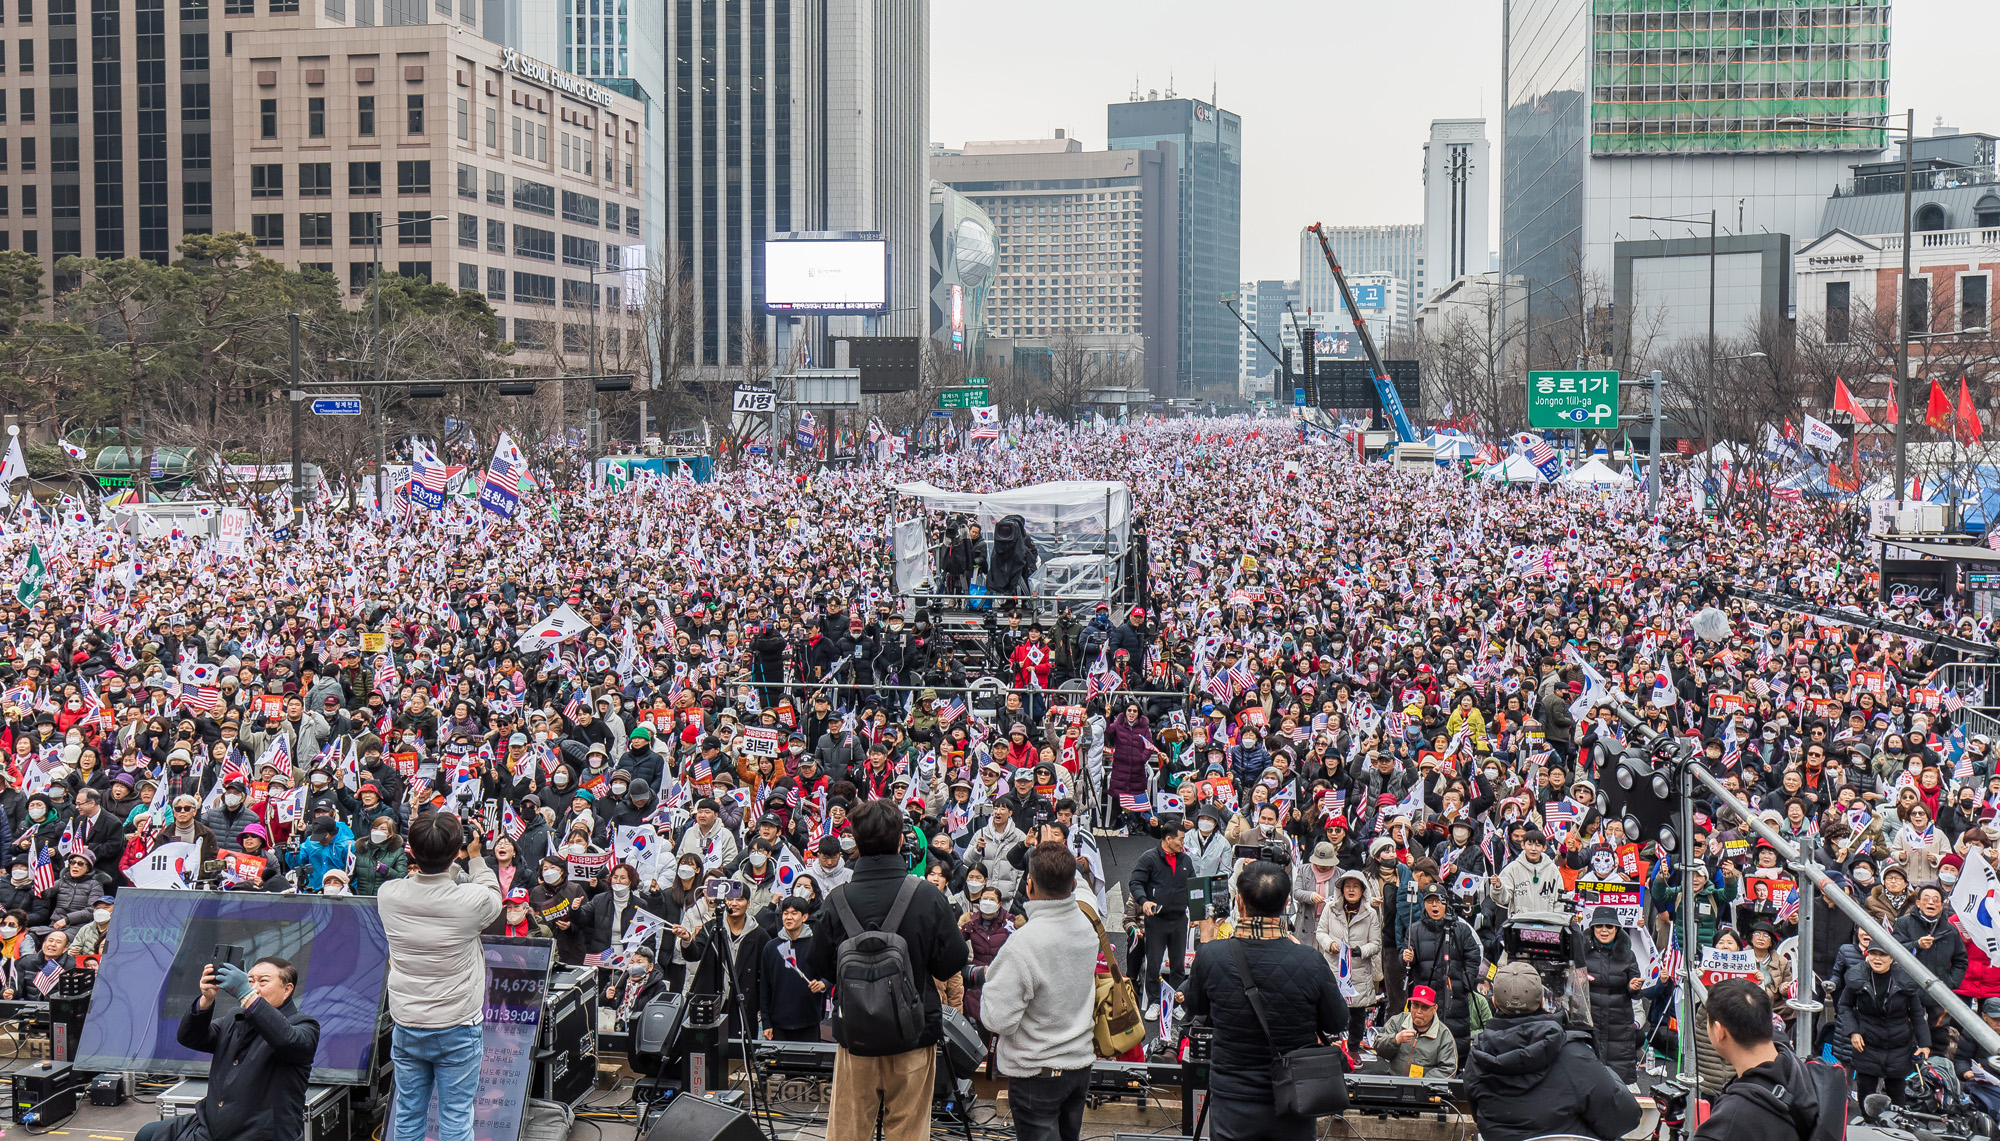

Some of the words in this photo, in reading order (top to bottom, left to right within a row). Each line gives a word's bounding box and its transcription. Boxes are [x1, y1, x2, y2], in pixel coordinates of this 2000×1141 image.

[521, 58, 549, 84] SEOUL
[550, 69, 586, 97] FINANCE
[586, 84, 614, 107] CENTER
[1809, 254, 1864, 265] 한국금융사박물관
[1535, 376, 1610, 394] 종로1가
[738, 393, 773, 410] 사형
[1535, 396, 1564, 408] Jongno
[1566, 396, 1592, 408] 1(il)-ga
[1575, 410, 1583, 420] 6
[412, 483, 443, 504] 포천가산
[481, 489, 515, 514] 포천소흘
[263, 709, 279, 718] 무효
[746, 728, 777, 739] 자유민주주의
[745, 739, 774, 755] 회복!
[1622, 852, 1636, 863] 원천
[1624, 862, 1639, 875] 무효
[1595, 883, 1626, 893] 우롱하는
[1620, 894, 1637, 903] 구속
[542, 898, 570, 916] 대통령이
[1617, 907, 1638, 917] 과자
[1712, 951, 1728, 961] 종북
[1731, 952, 1748, 962] 좌파
[1702, 959, 1721, 969] CCP
[1722, 961, 1756, 970] 중국공산당
[485, 1008, 536, 1023] 01:39:04
